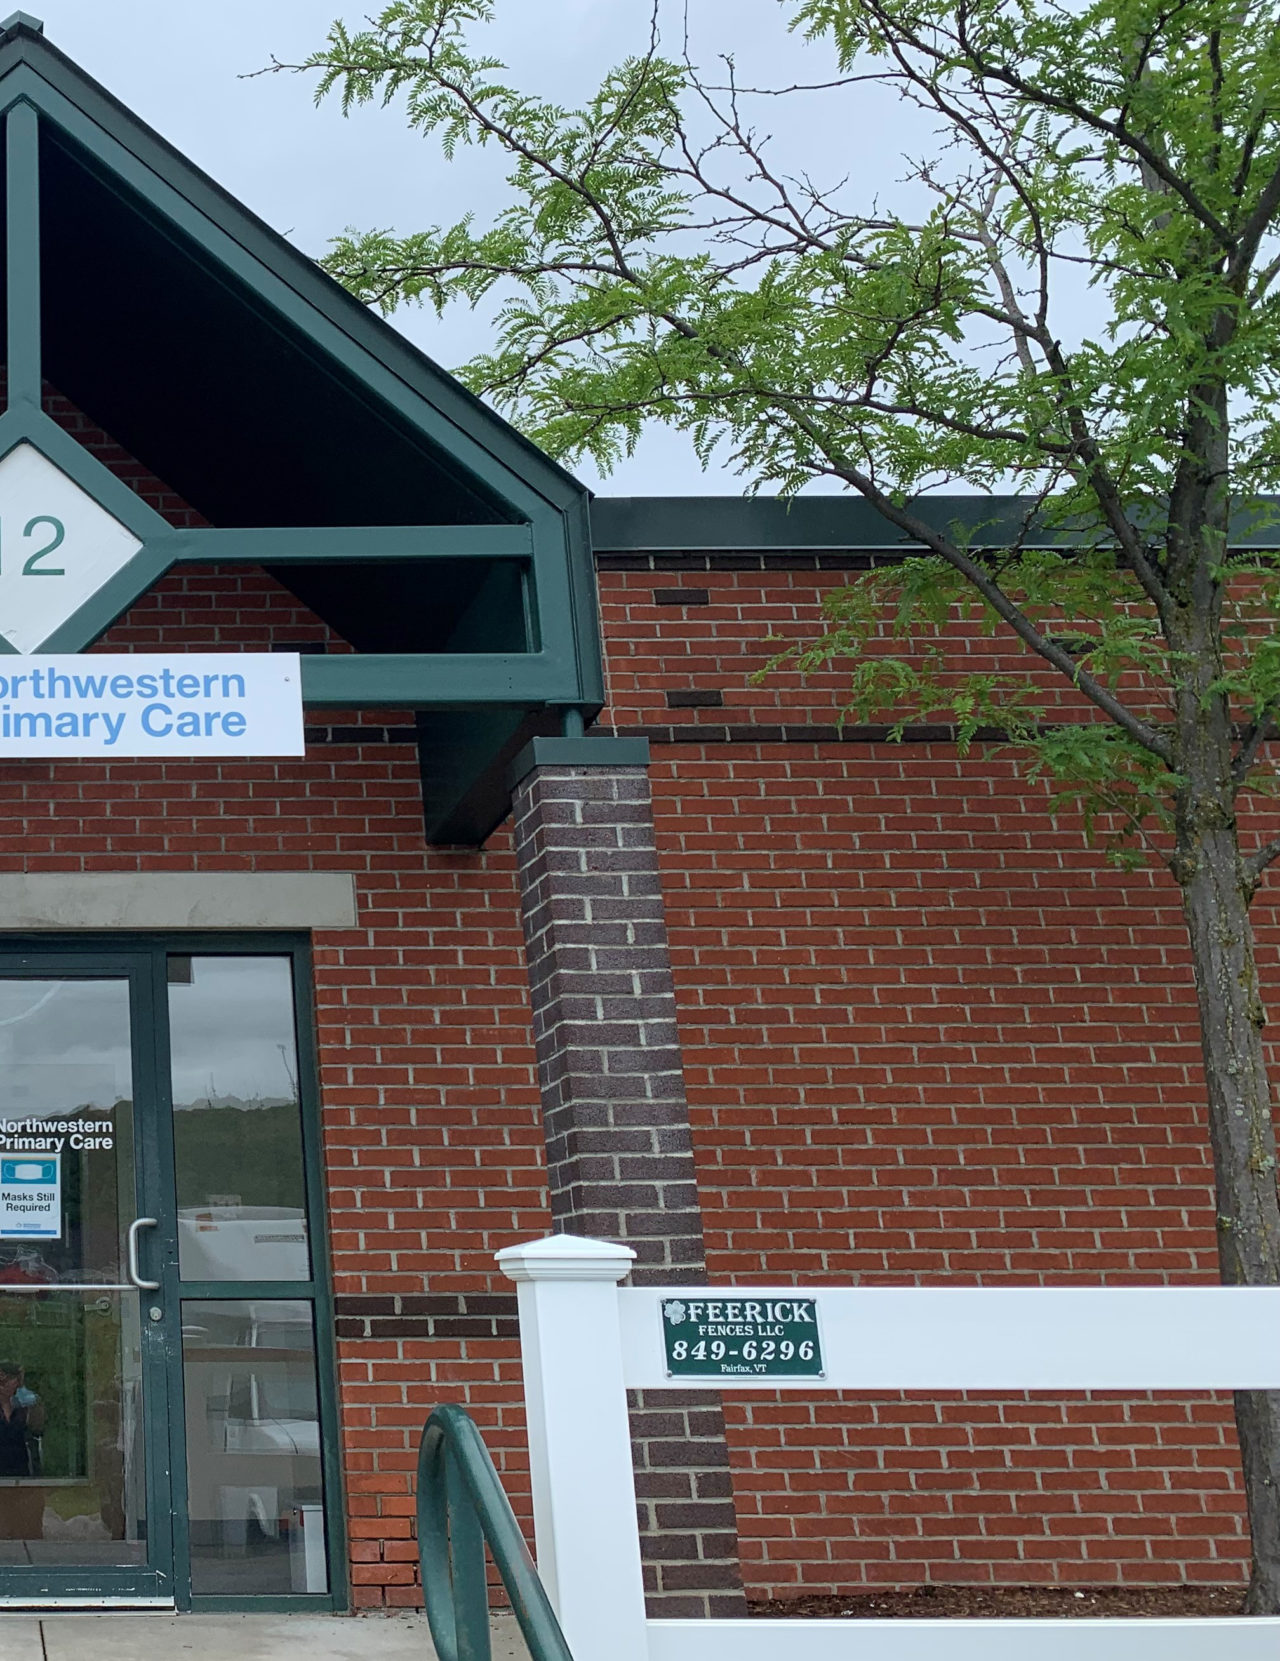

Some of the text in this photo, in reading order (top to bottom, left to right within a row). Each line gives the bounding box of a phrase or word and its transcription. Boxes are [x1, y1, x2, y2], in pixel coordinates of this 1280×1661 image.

[141, 703, 247, 737] Care
[69, 1134, 113, 1150] Care
[1, 1192, 55, 1202] Masks Still
[6, 1202, 51, 1213] Required
[687, 1302, 814, 1323] FEERICK
[698, 1325, 785, 1336] FENCES LLC
[672, 1340, 814, 1361] 849-6296
[720, 1363, 767, 1374] Fairfax, VT
